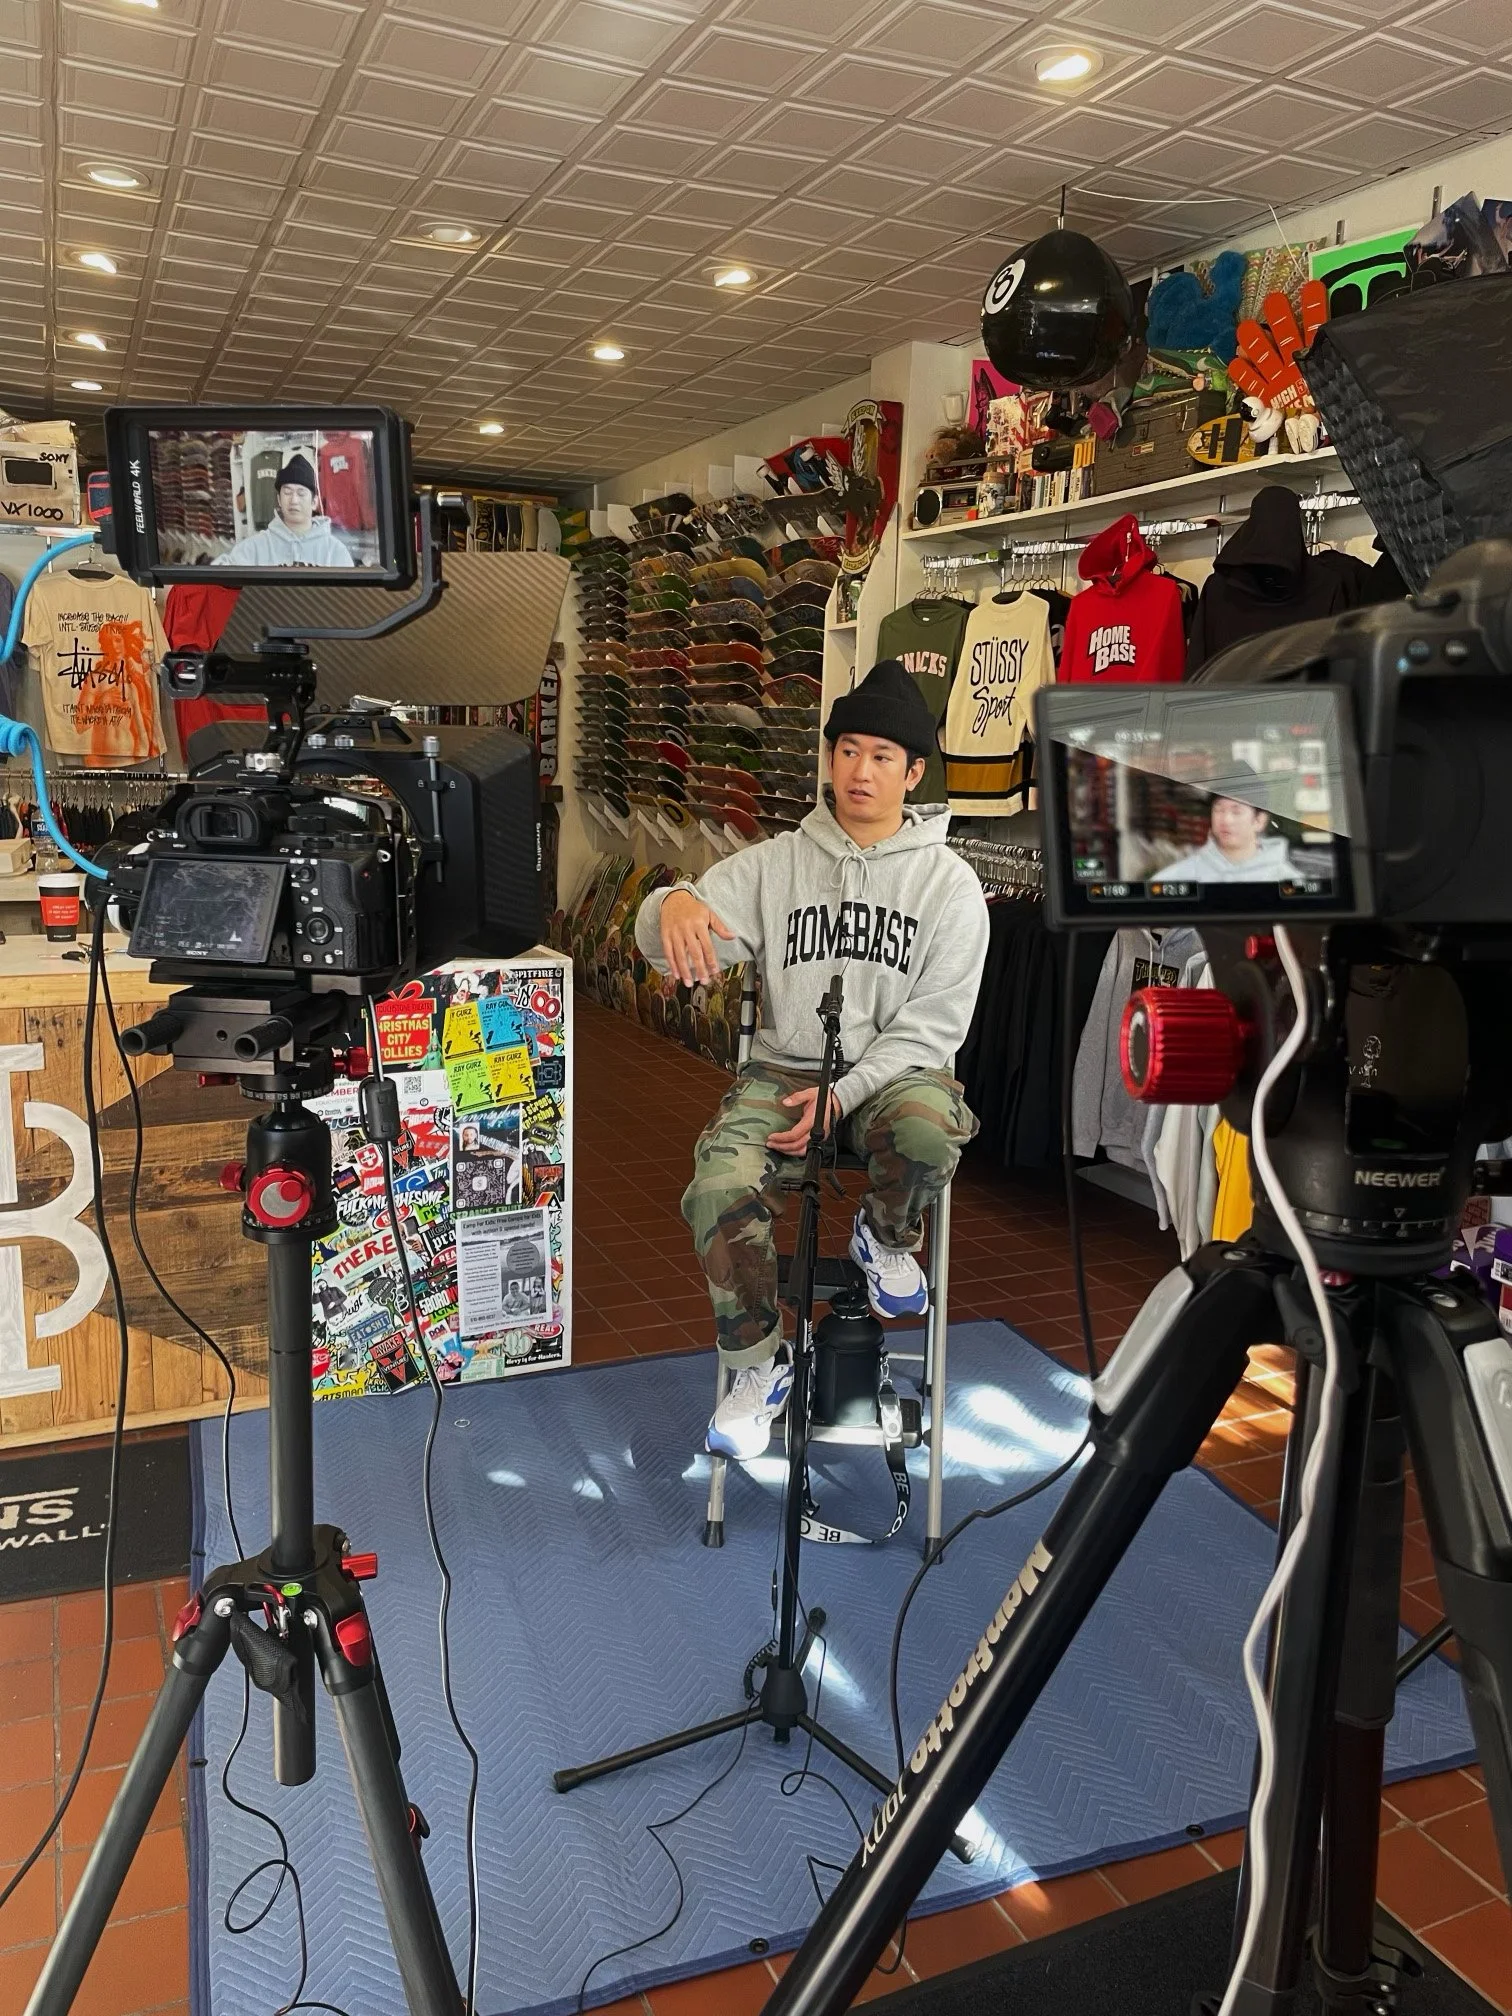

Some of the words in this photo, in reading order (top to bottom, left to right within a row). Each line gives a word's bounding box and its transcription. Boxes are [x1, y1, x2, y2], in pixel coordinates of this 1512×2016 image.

[1269, 384, 1298, 409] HIGH
[39, 452, 69, 463] SONY
[129, 459, 141, 478] 4K
[132, 481, 145, 534] FEELWORLD
[1089, 625, 1131, 655] HOME
[899, 651, 948, 678] NICKS
[970, 637, 1029, 686] STÜSSY
[1094, 643, 1137, 675] BASE
[971, 685, 1017, 737] Sport
[782, 901, 919, 976] HOMEBASE
[515, 969, 554, 979] SPITFIRE
[379, 1019, 429, 1033] HRISTMAS
[387, 1033, 411, 1045] CITY
[1355, 1171, 1440, 1187] NEEWER
[333, 1234, 397, 1280] THERE
[534, 1323, 555, 1333] REAL
[374, 1335, 402, 1357] AWAKE
[910, 1538, 1053, 1775] Manfrotto
